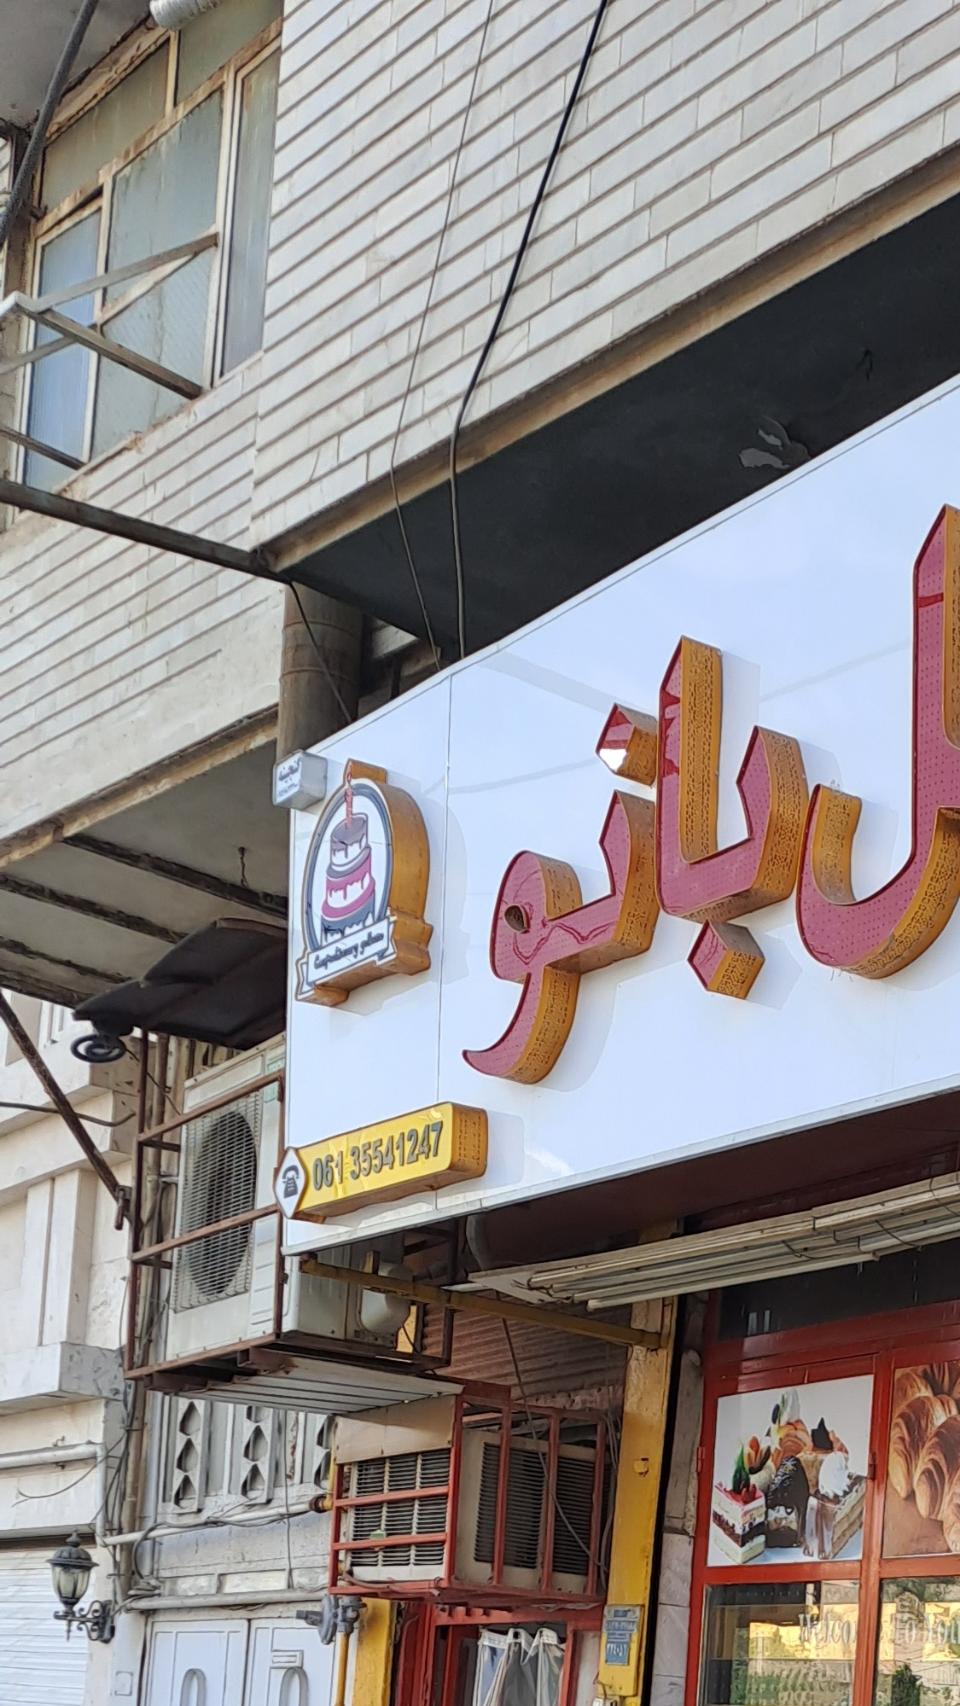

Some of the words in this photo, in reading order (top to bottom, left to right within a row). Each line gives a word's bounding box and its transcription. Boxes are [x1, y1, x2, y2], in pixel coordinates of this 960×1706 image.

[463, 636, 808, 1084] بانو
[313, 1150, 344, 1191] 061
[350, 1120, 444, 1181] 35541247
